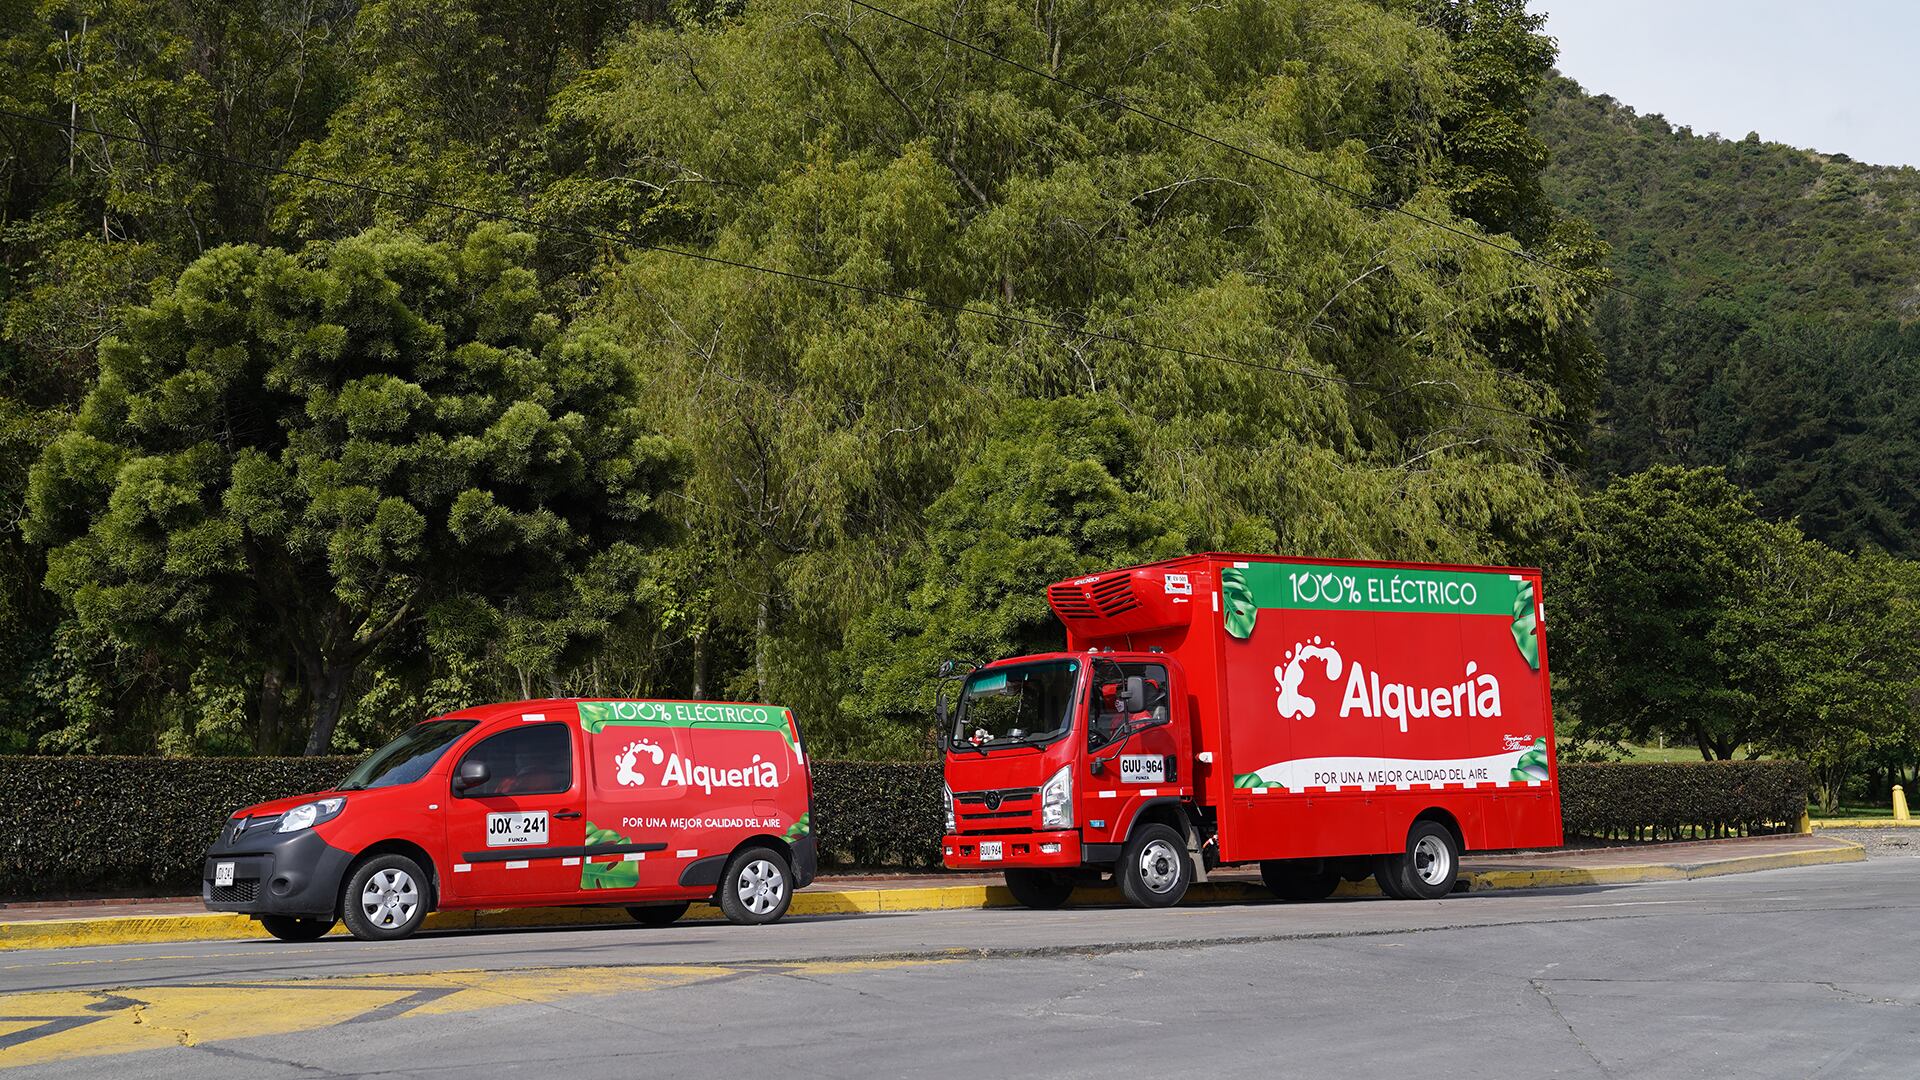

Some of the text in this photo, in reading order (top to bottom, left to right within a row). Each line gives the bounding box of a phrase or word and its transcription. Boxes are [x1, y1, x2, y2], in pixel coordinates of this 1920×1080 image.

[1289, 571, 1477, 605] 100% ELÉCTRICO
[1339, 660, 1501, 732] Alquería
[610, 702, 768, 723] 100% ELÉCTRICO
[661, 753, 779, 795] Alquería
[1122, 759, 1162, 773] GUU 964
[1314, 768, 1488, 785] POR UNA MEJOR CALIDAD DEL AIRE
[490, 816, 546, 834] JOX 241
[622, 817, 781, 830] POR UNA MEJOR CALIDAD DEL AIRE
